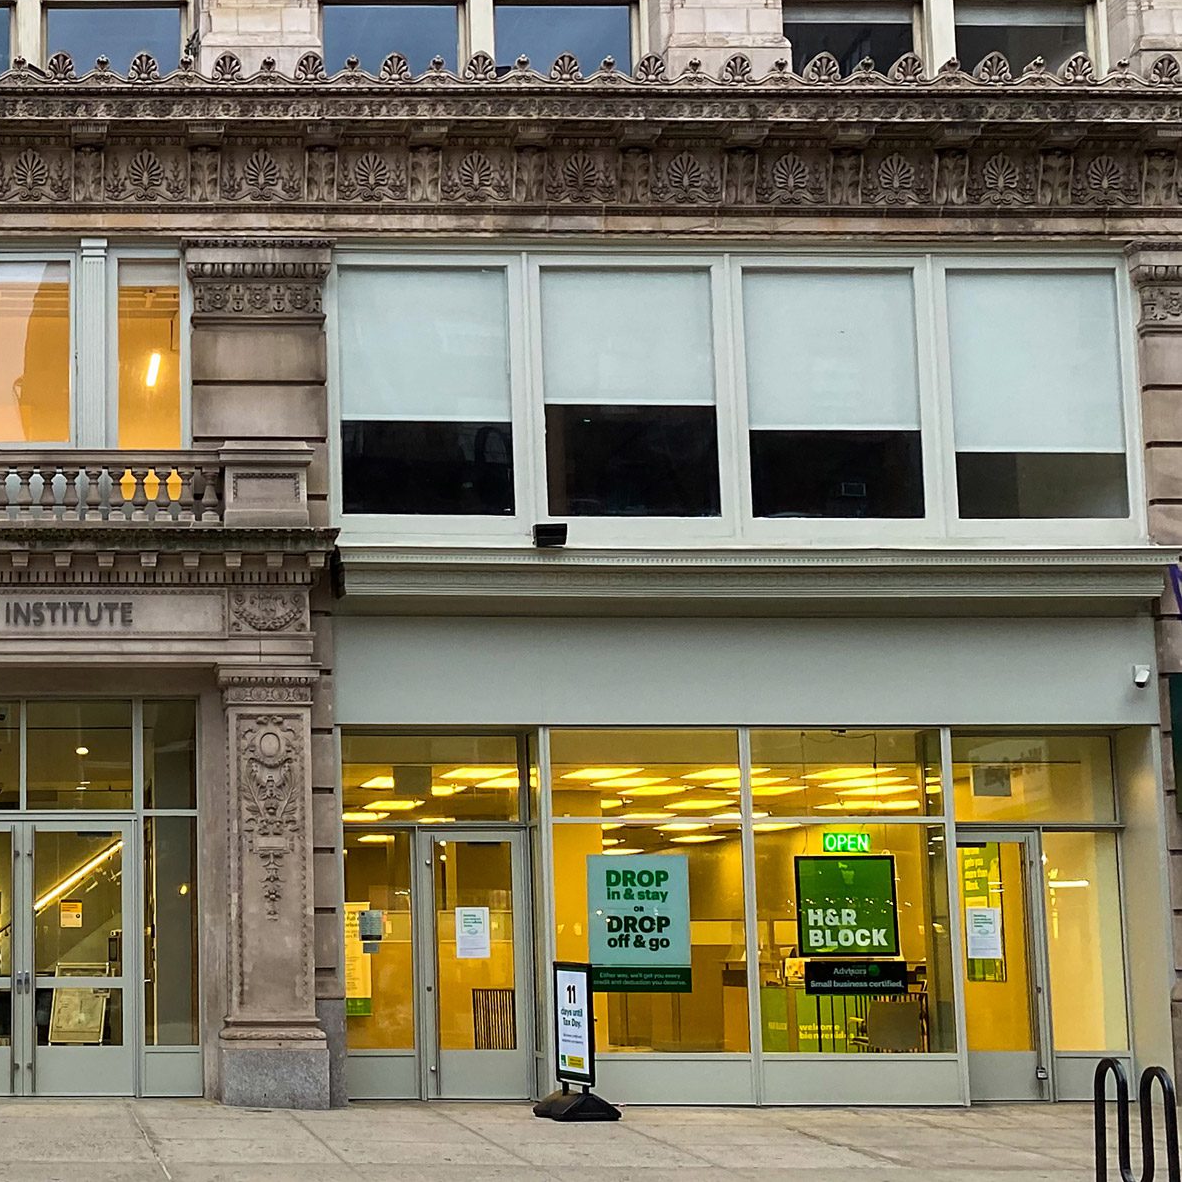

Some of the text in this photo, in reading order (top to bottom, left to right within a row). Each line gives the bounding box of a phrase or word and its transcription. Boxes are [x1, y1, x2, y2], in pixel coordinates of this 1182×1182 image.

[5, 602, 133, 626] INSTITUTE
[825, 835, 868, 851] OPEN
[605, 870, 669, 887] DROP
[606, 888, 668, 903] in & stay
[606, 916, 671, 933] DROP
[807, 909, 857, 926] H&R
[607, 934, 670, 952] off & go
[809, 929, 888, 947] BLOCK
[566, 985, 576, 1004] 11
[561, 1008, 583, 1017] days until
